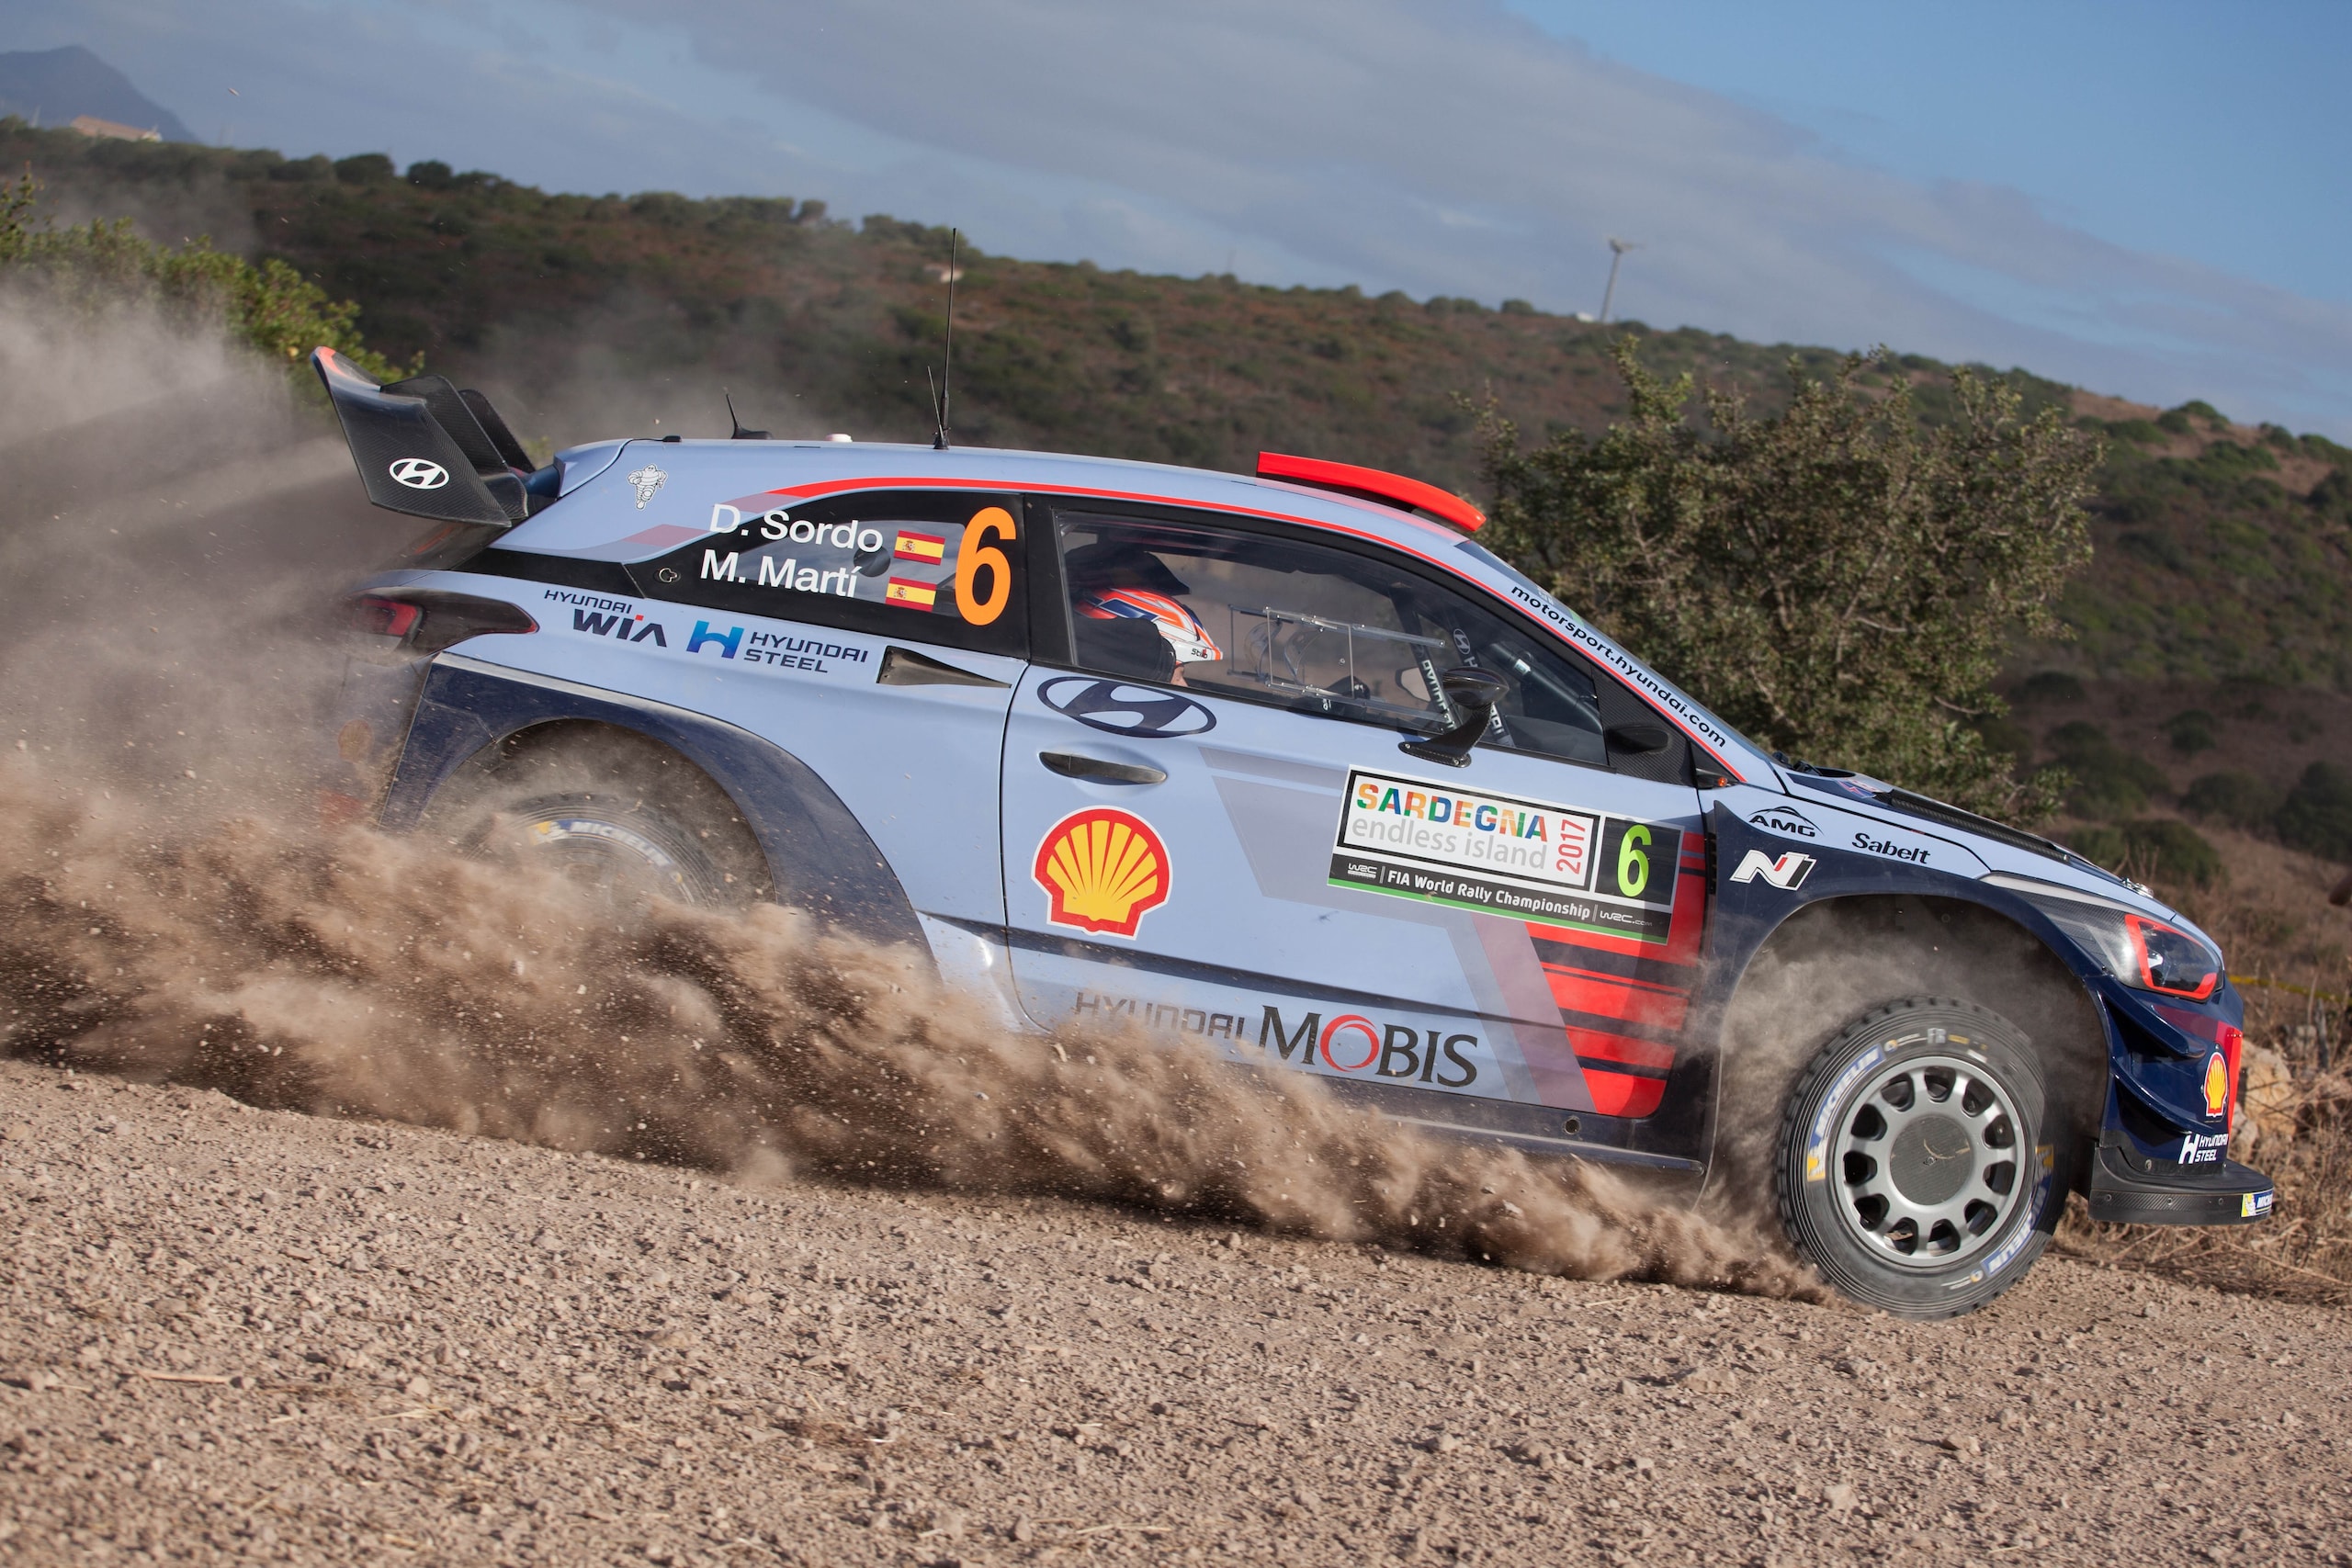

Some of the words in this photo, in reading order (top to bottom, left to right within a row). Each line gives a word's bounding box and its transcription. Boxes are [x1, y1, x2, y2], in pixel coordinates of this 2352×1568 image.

[708, 503, 749, 536] D.
[760, 510, 884, 552] Sordo
[700, 549, 746, 583] M.
[758, 555, 863, 598] Martí
[955, 506, 1017, 626] 6
[544, 590, 632, 614] HYUNDAI
[744, 649, 829, 673] STEEL
[750, 631, 868, 663] HYUNDAI
[1510, 585, 1726, 748] motorsport.hyundai.com
[1356, 783, 1548, 842] SARDEGNA
[1748, 815, 1816, 838] AMG
[1348, 863, 1377, 874] WRC
[1351, 818, 1457, 853] endless
[1464, 831, 1547, 870] island
[1555, 818, 1586, 874] 2017
[1617, 824, 1652, 897] 6
[1851, 832, 1931, 864] Sabelt
[1387, 870, 1410, 886] FIA
[1414, 874, 1454, 894] World
[1457, 883, 1492, 903] Rally
[1496, 890, 1590, 920] Championship
[1259, 1005, 1478, 1089] MOBIS
[2195, 1149, 2217, 1162] STEEL
